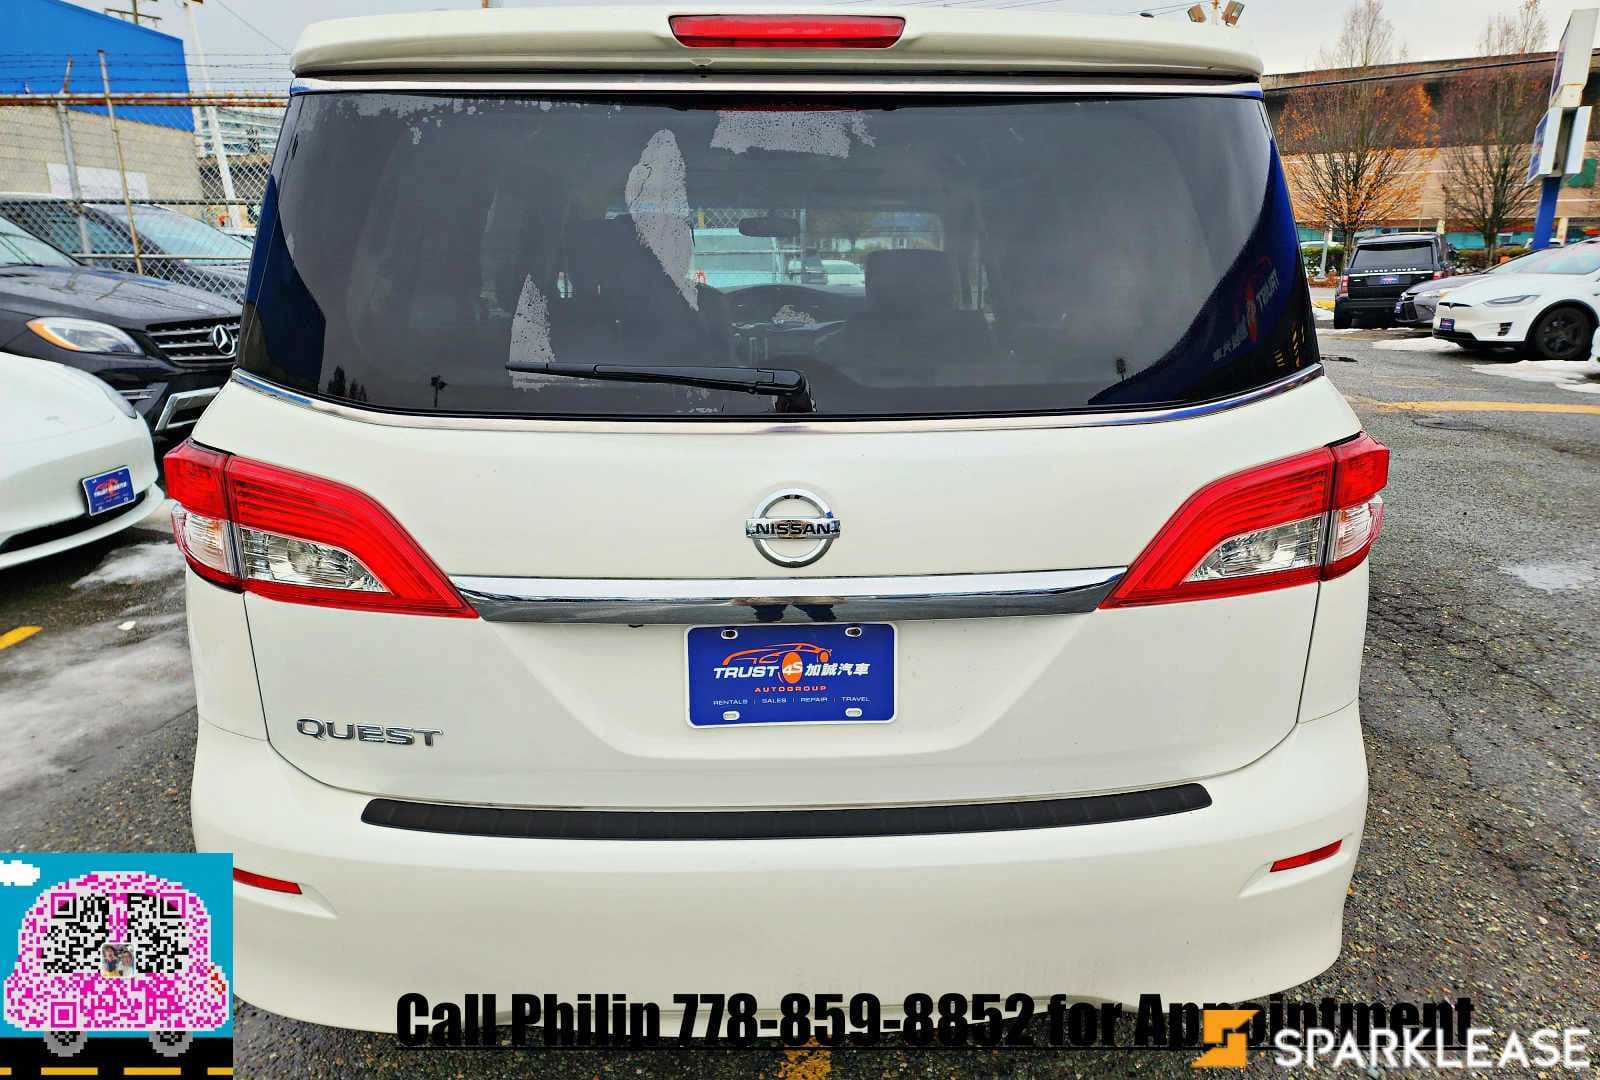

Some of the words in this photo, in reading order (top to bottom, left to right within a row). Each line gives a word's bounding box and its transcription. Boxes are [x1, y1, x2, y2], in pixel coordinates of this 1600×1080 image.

[755, 523, 830, 535] NISSAN
[713, 665, 779, 680] TRUST
[782, 661, 803, 676] 4S
[805, 662, 870, 677] 加誠汽車
[754, 685, 827, 693] AUTOGROUP
[296, 718, 444, 747] QUEST
